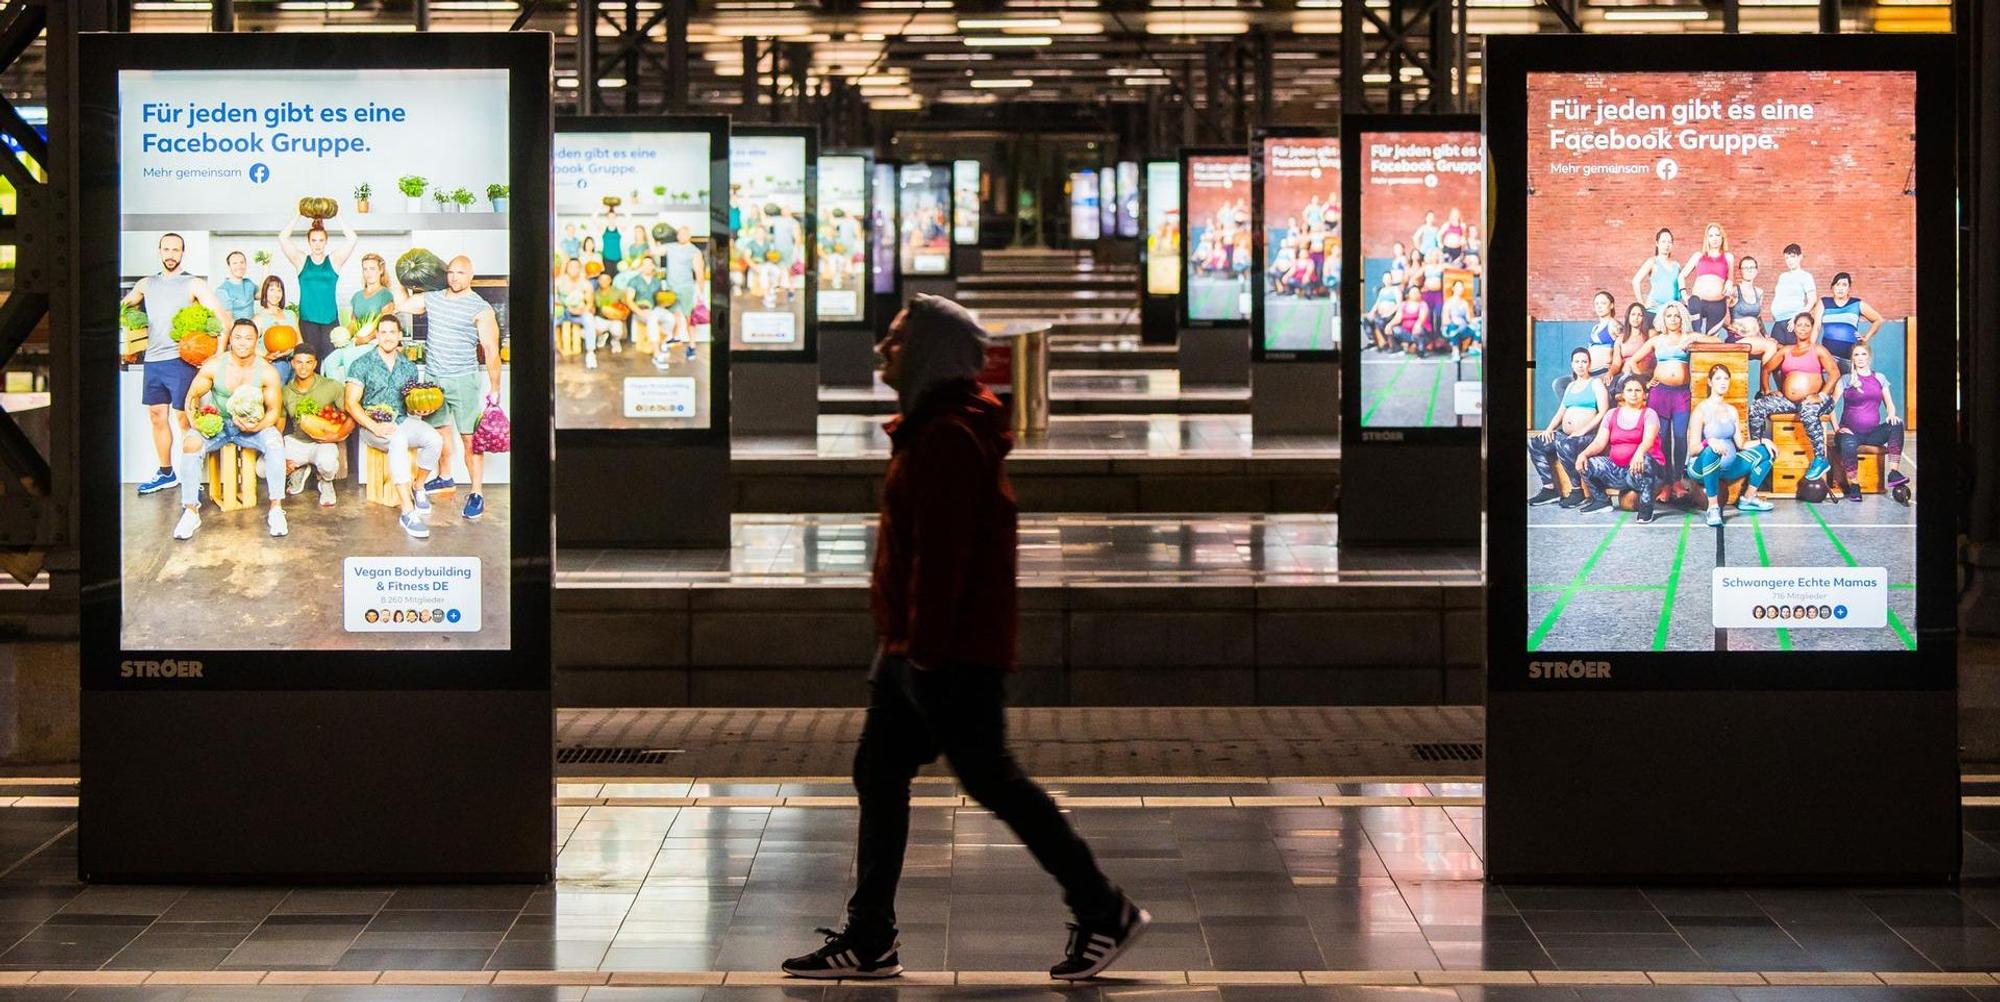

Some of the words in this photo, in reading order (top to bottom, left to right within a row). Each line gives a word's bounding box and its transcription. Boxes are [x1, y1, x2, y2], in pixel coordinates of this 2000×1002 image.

[143, 102, 183, 122] Für
[187, 102, 257, 128] jeden
[264, 101, 314, 128] gibt
[320, 107, 348, 122] es
[354, 101, 406, 122] eine
[1550, 98, 1591, 120] Für
[1594, 98, 1666, 126] jeden
[1671, 98, 1722, 126] gibt
[1727, 103, 1756, 120] es
[1761, 98, 1814, 120] eine
[143, 132, 264, 152] Facebook
[271, 132, 371, 158] Gruppe.
[1550, 128, 1673, 150] Facebook
[1679, 128, 1779, 156] Gruppe.
[143, 167, 173, 178] Mehr
[175, 168, 242, 180] gemeinsam
[1550, 163, 1581, 174] Mehr
[1583, 163, 1649, 176] gemeinsam
[354, 567, 392, 579] Vegan
[394, 566, 471, 579] Bodybuilding
[376, 581, 385, 591] &
[388, 581, 430, 591] Fitness
[432, 581, 449, 591] DE
[1722, 577, 1795, 589] Schwangere
[1797, 577, 1831, 588] Echte
[1833, 577, 1877, 588] Mamas
[120, 659, 204, 678] STRÖER
[1528, 659, 1612, 679] STRÖER
